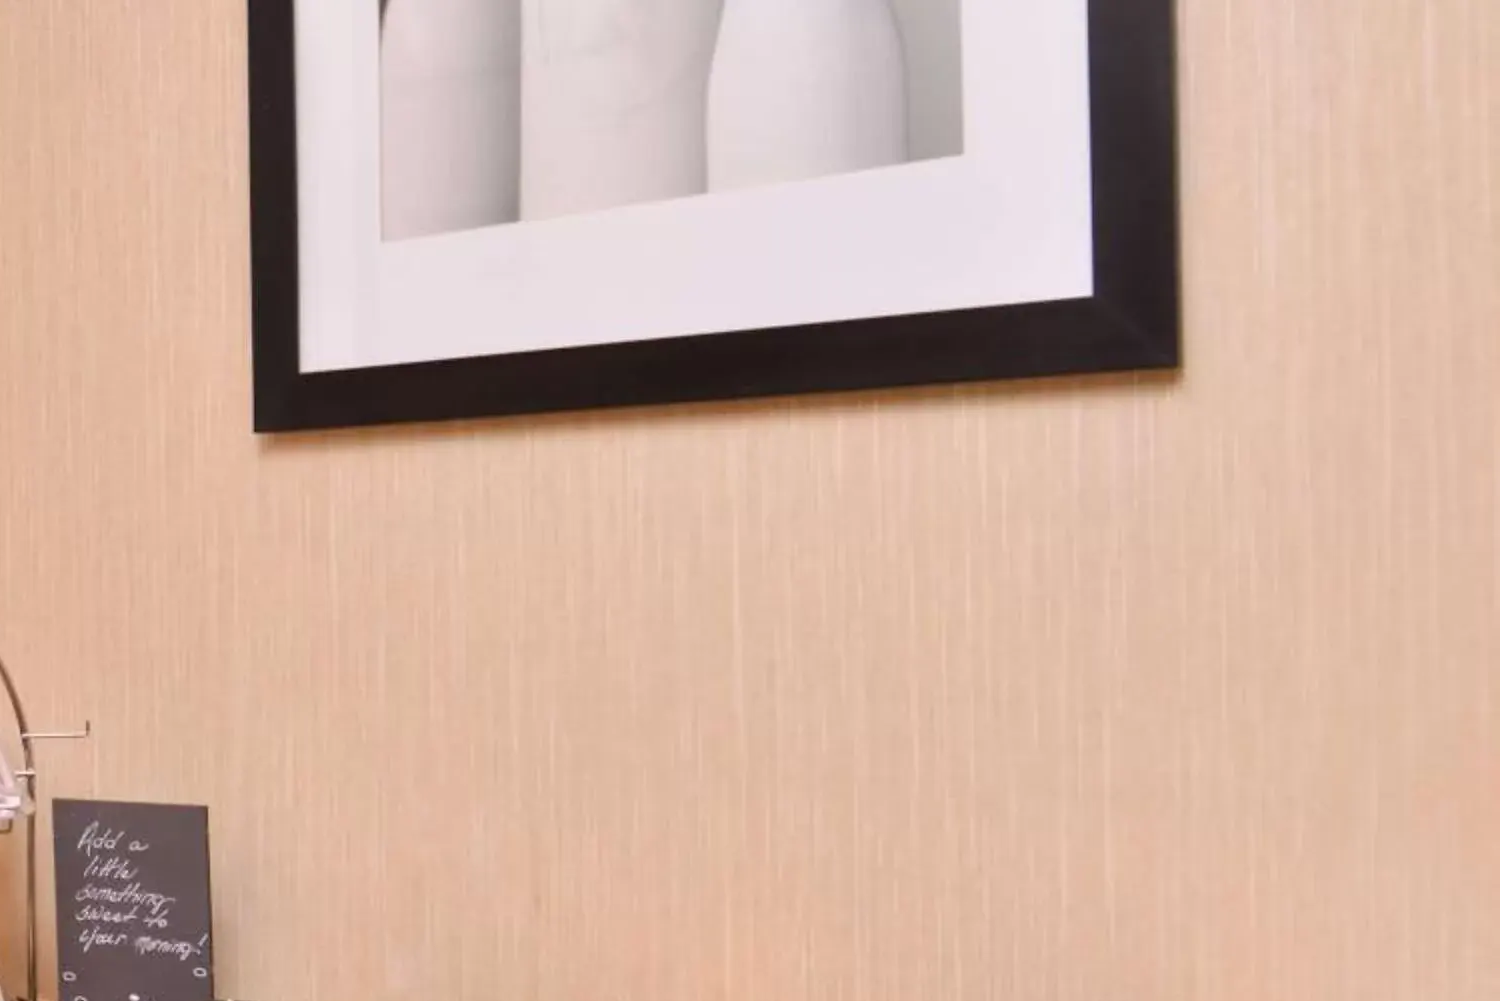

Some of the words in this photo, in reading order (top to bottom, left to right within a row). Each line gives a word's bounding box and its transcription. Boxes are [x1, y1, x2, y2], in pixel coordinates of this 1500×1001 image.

[77, 821, 124, 856] Add
[129, 840, 148, 851] a
[84, 855, 138, 880] little
